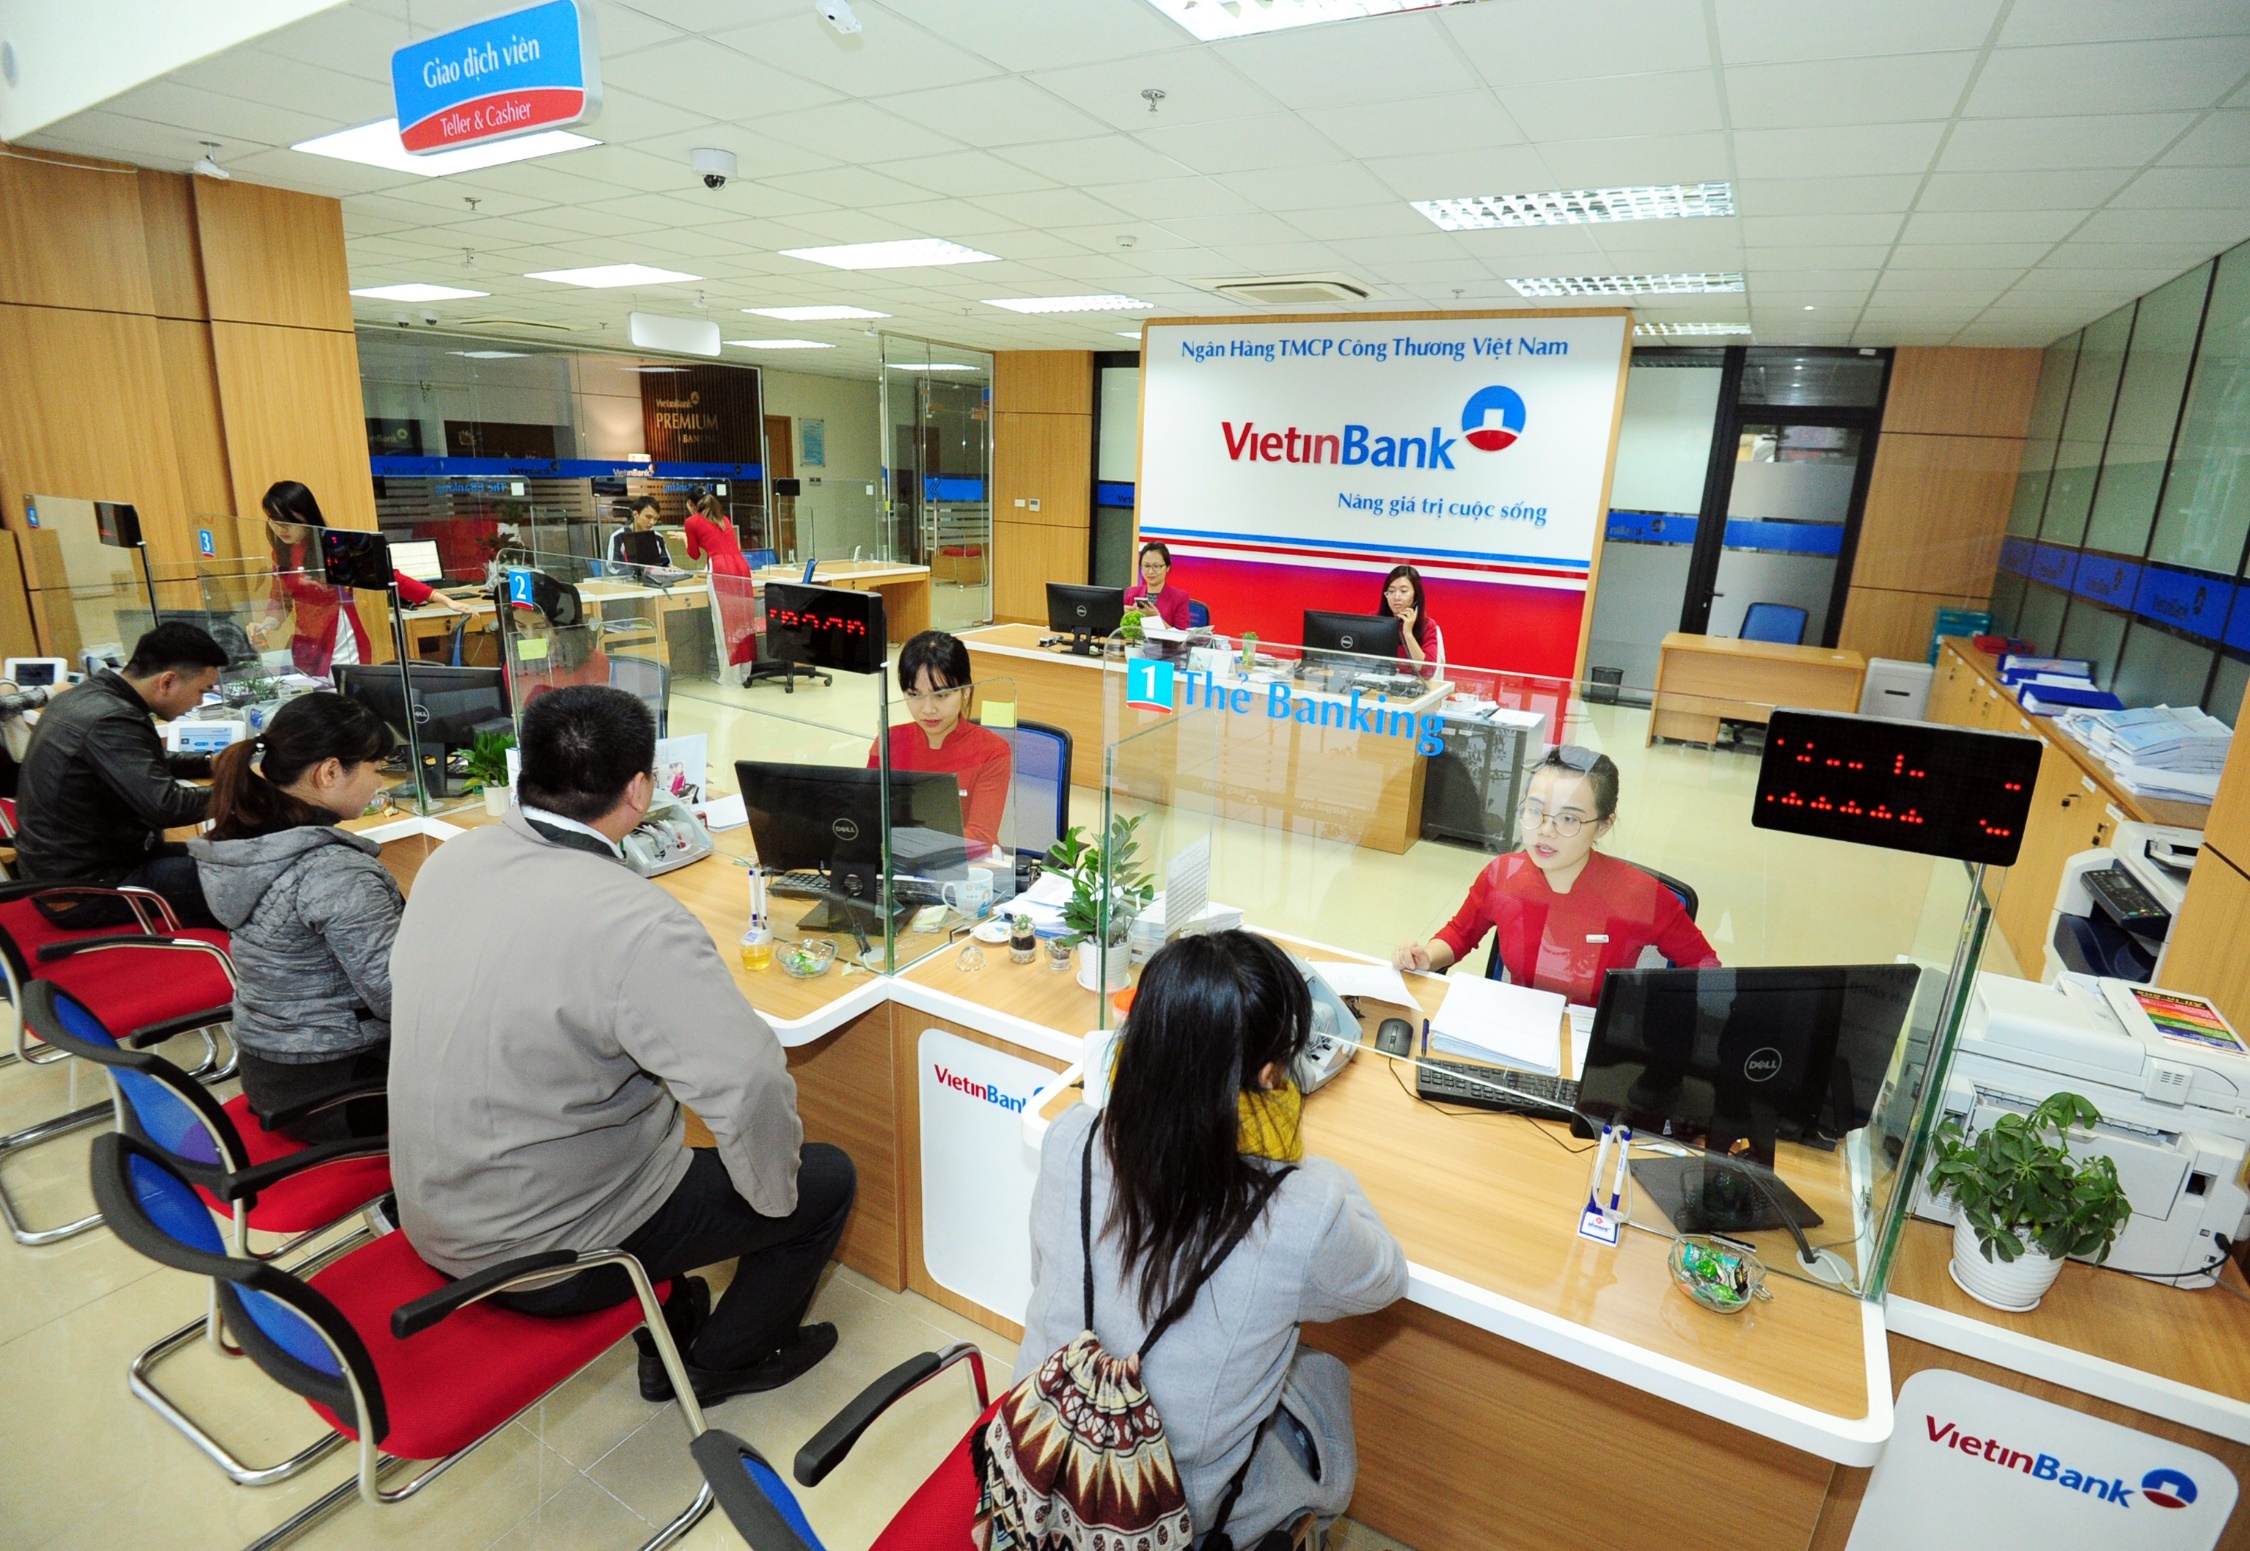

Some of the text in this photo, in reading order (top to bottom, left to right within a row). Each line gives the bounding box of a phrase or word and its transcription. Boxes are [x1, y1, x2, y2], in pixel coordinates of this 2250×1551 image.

[423, 34, 541, 88] Giao dịch viên
[440, 100, 531, 137] Teller & Cashier
[1182, 337, 1568, 363] Ngân Hàng TMCP Công Thương Việt Nam
[656, 412, 719, 430] PREMIUM
[1221, 422, 1457, 470] VietinBank
[1338, 493, 1548, 527] Nâng giá trị cuộc sống
[202, 532, 210, 551] 3
[515, 575, 526, 600] 2
[1141, 664, 1447, 757] 1 Thẻ Banking
[1748, 1060, 1777, 1070] DELL
[1926, 1414, 2135, 1509] VietinBank
